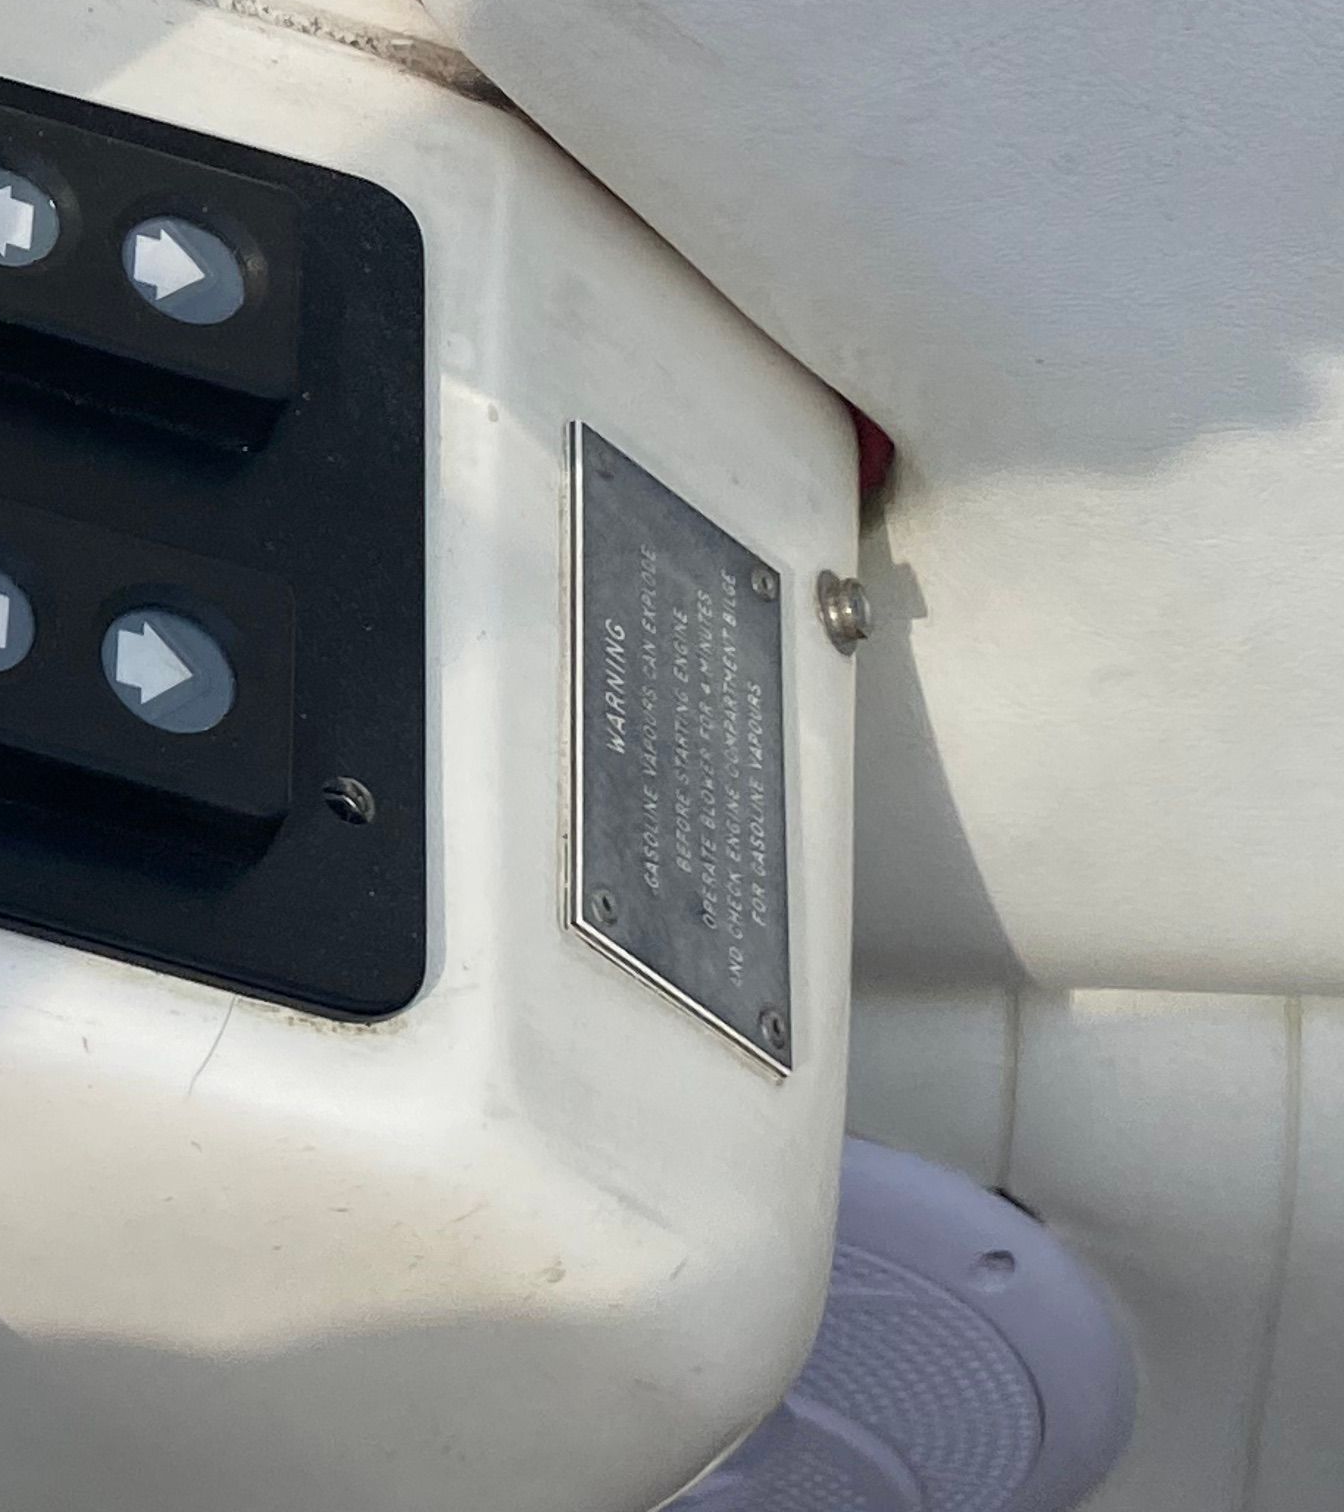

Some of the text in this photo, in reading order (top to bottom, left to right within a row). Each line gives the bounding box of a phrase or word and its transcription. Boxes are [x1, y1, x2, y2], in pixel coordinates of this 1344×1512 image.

[697, 591, 713, 676] MINUTES
[721, 570, 737, 626] BILGE
[604, 618, 625, 755] WARNING
[641, 546, 658, 888] GASOLINE VAPOURS CAN EXPLODE
[672, 608, 690, 870] BEFORE STARTING ENGINE
[699, 702, 714, 741] FOR
[722, 629, 739, 778] COMPARTMENT
[724, 786, 740, 861] ENGINE
[747, 681, 766, 925] FOR GASOLINE VAPOURS
[700, 836, 716, 929] OPERATE
